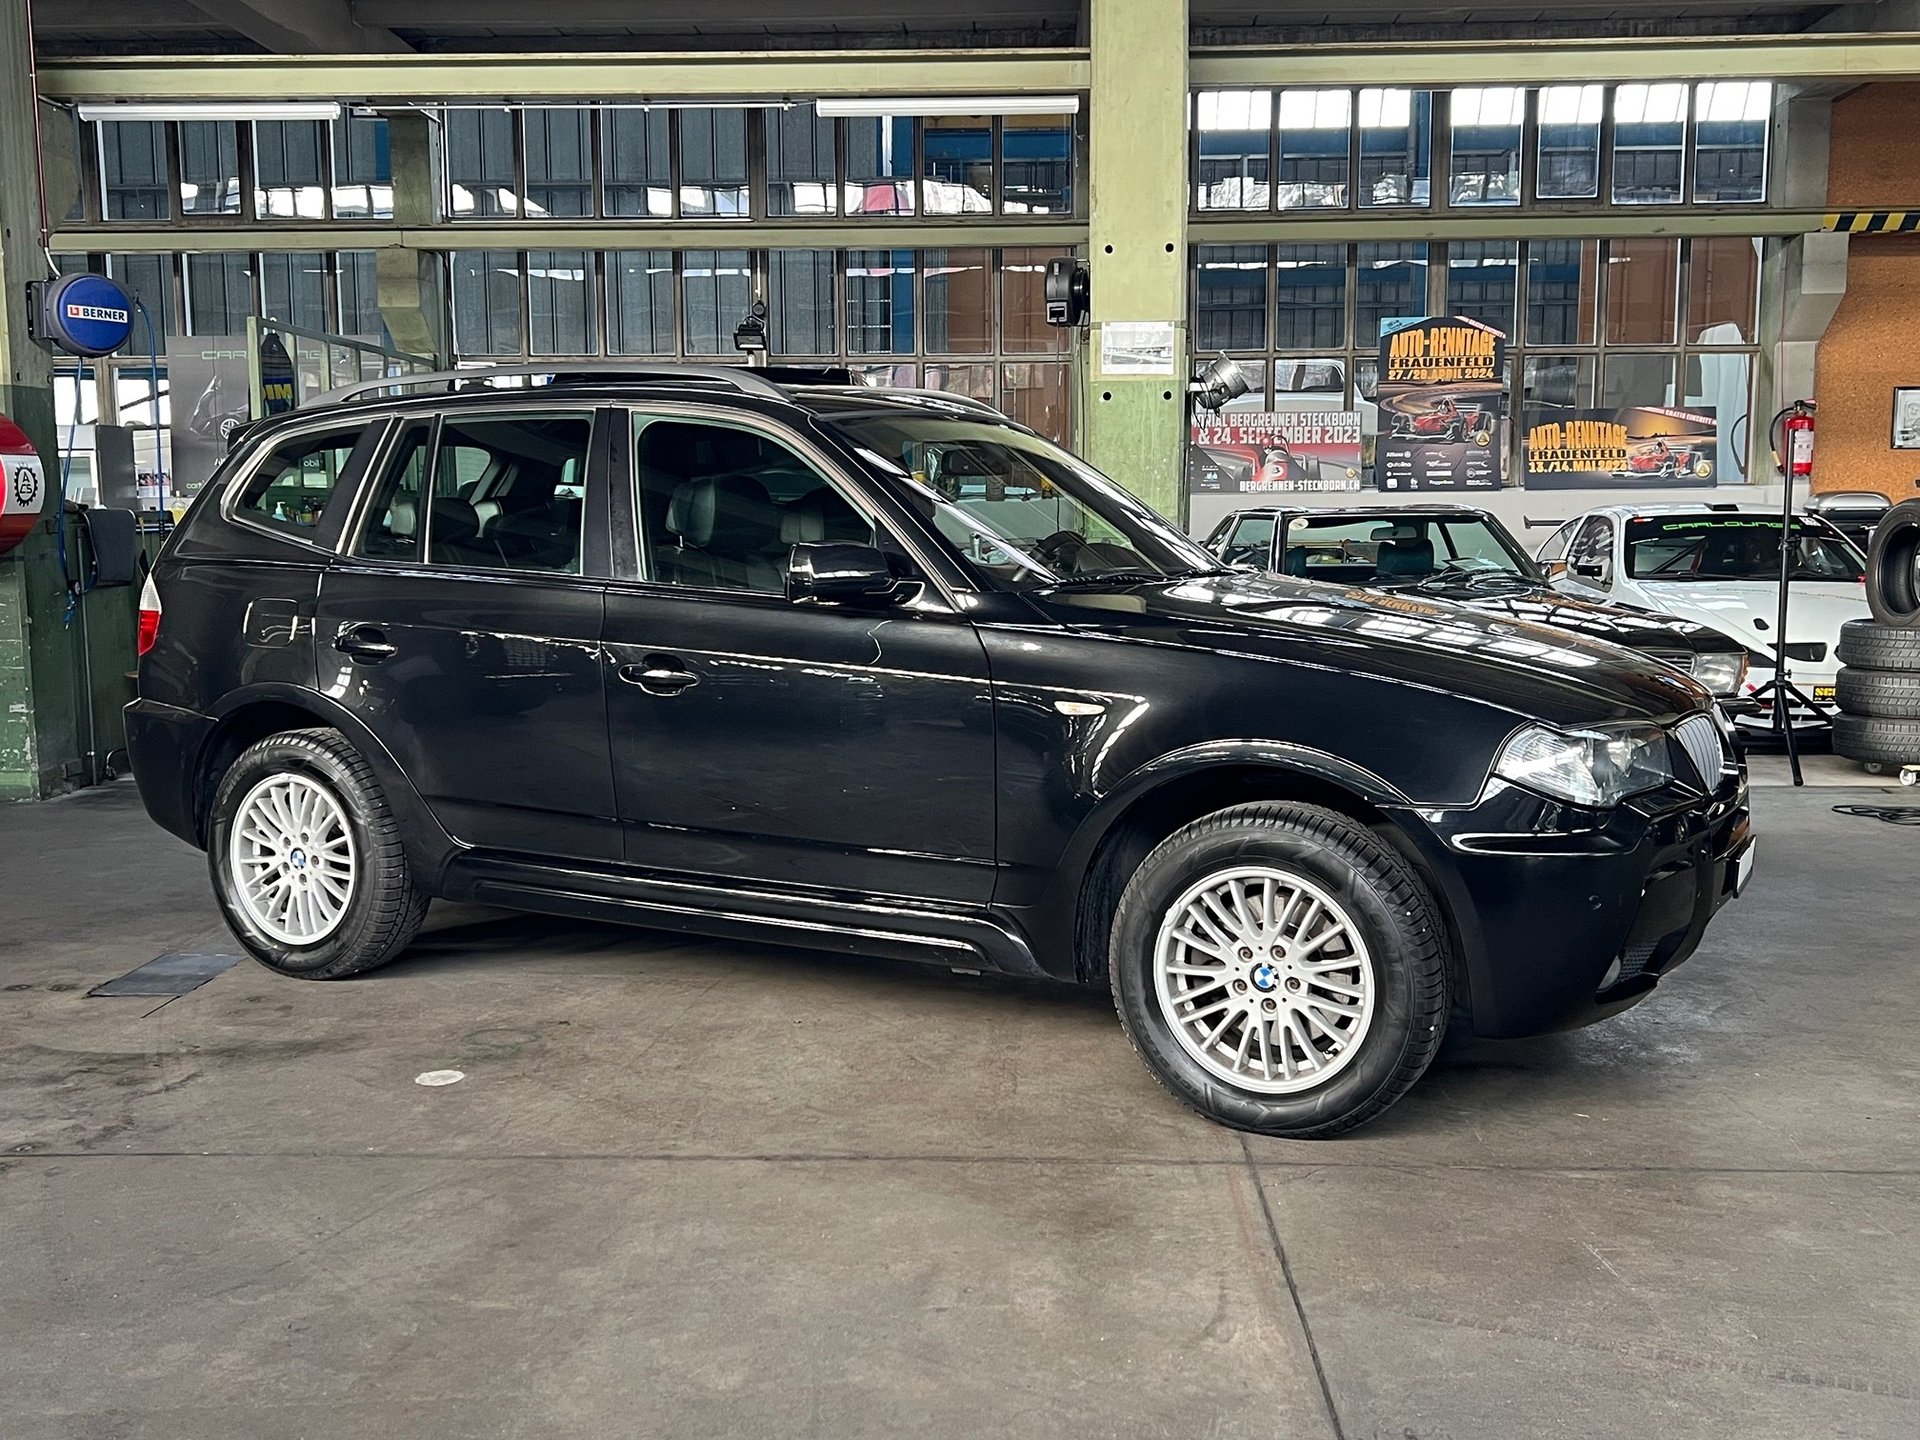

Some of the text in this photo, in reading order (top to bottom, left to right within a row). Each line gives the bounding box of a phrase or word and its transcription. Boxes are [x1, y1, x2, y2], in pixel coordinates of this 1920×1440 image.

[83, 308, 125, 321] BERNER
[1390, 327, 1496, 357] AUTO-RENNTAGE
[1390, 357, 1494, 368] FRAUENFELD
[1464, 368, 1494, 379] 2024
[1230, 412, 1298, 428] BERGRENNEN
[1301, 412, 1361, 427] STECKBORN
[1198, 427, 1360, 445] & 24. SEPTEMBER 2023
[1529, 421, 1628, 450] AUTO-RENNTAGE
[1530, 450, 1627, 460] FRAUENFELD
[1598, 460, 1628, 472] 2023
[1239, 479, 1361, 492] BERGRENNEN-STECKBORN.CH
